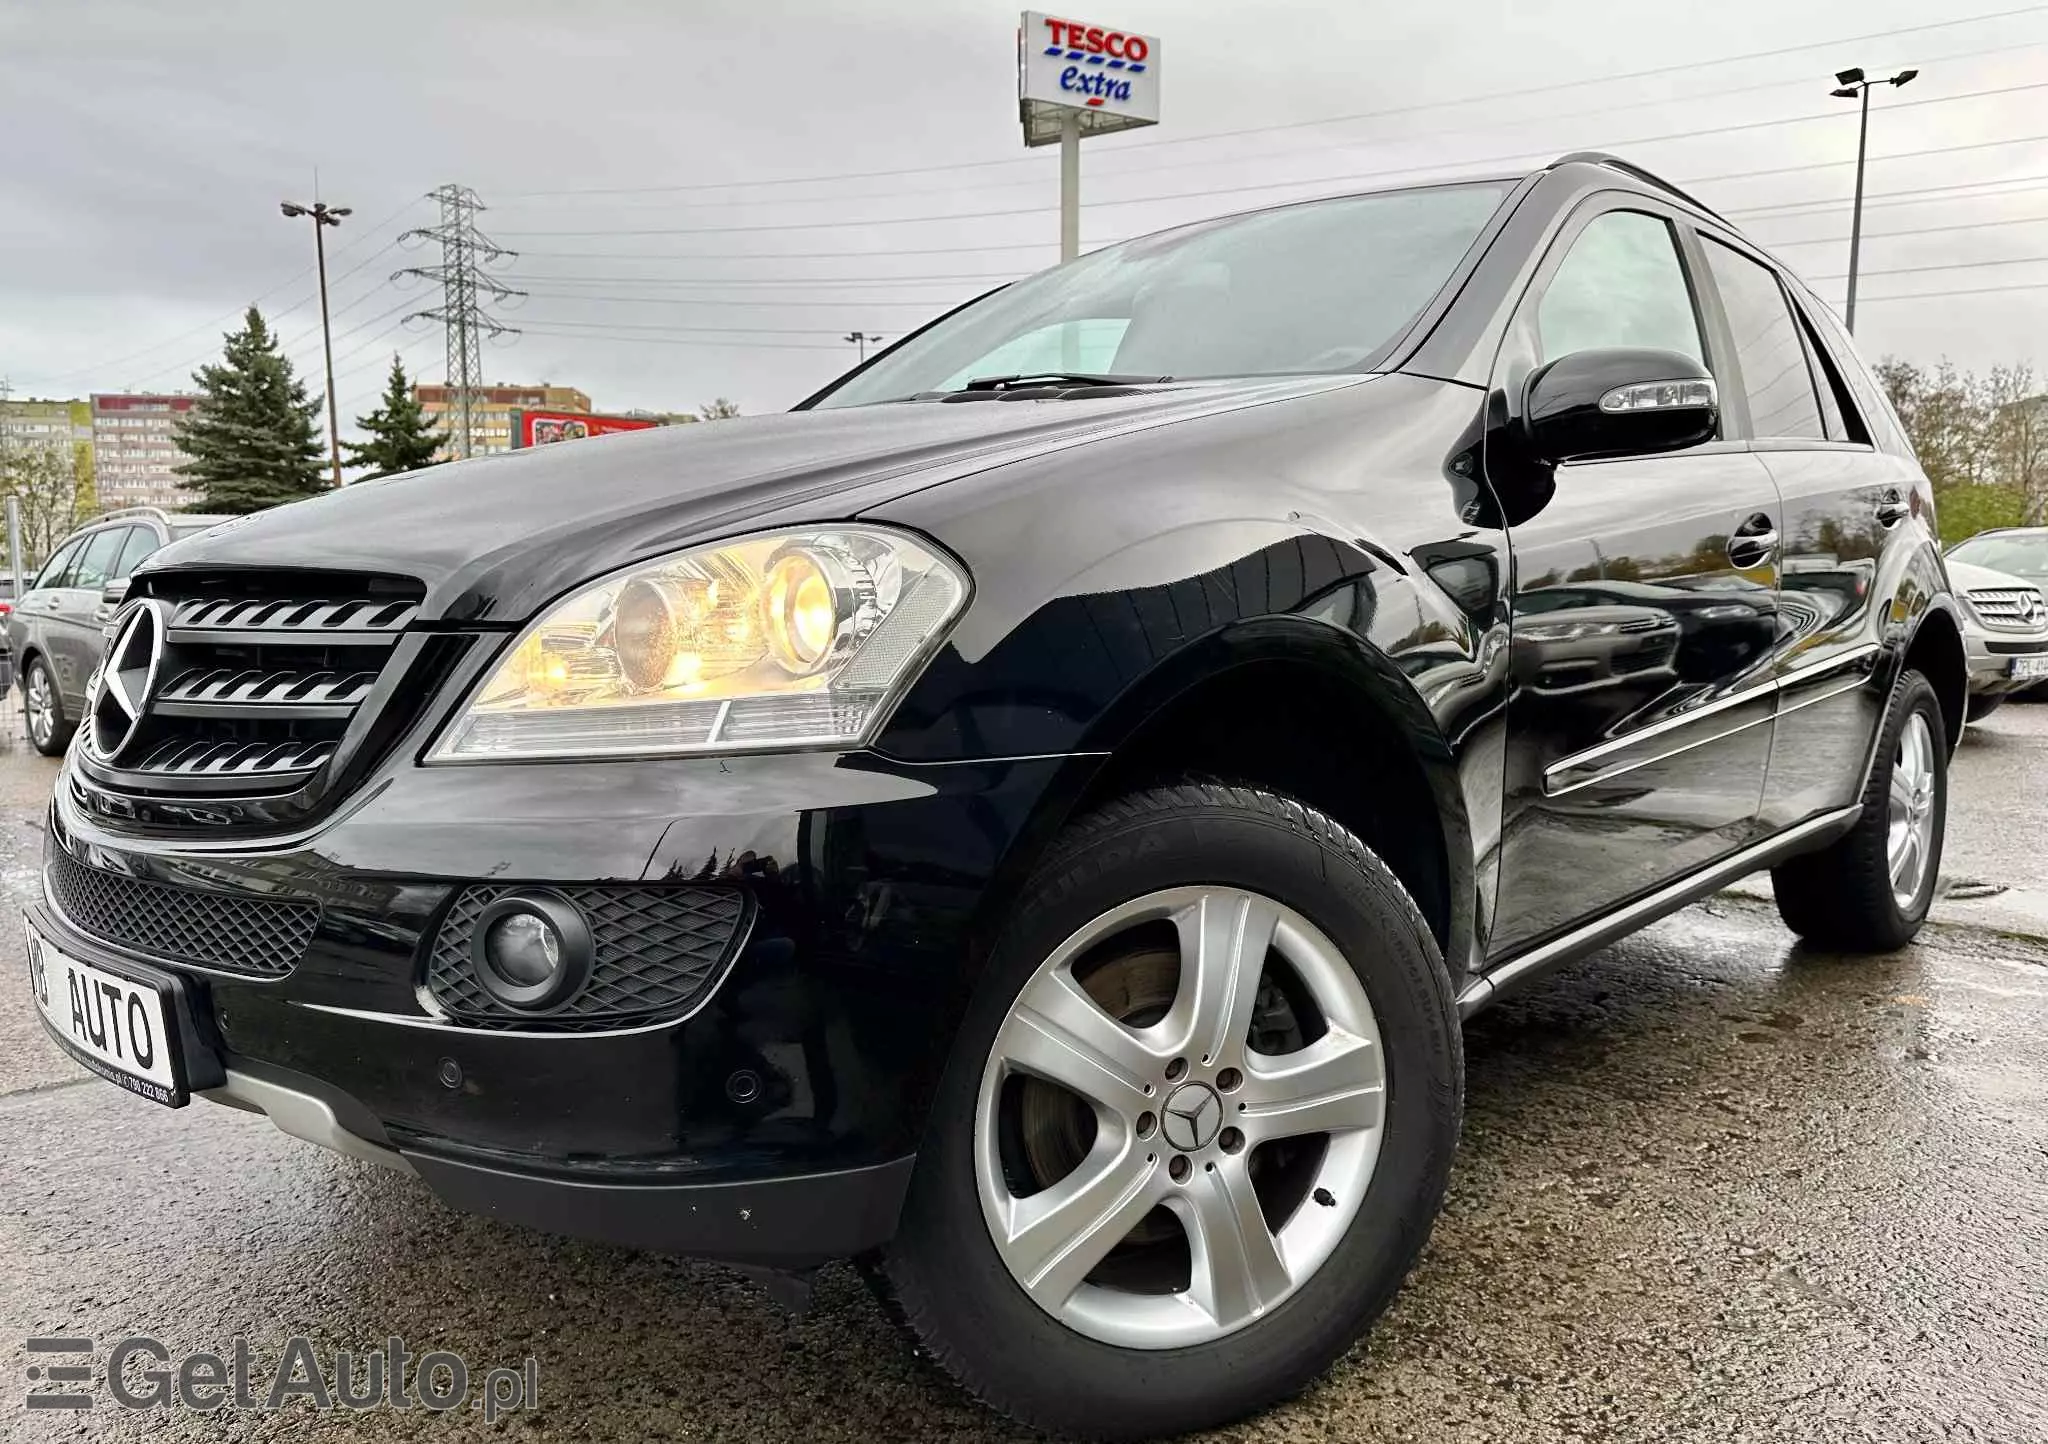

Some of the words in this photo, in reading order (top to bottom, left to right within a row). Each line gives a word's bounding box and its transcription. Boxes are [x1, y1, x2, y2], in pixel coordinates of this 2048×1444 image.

[1044, 18, 1149, 62] TESCO
[1060, 66, 1132, 101] extra
[68, 967, 153, 1070] AUTO
